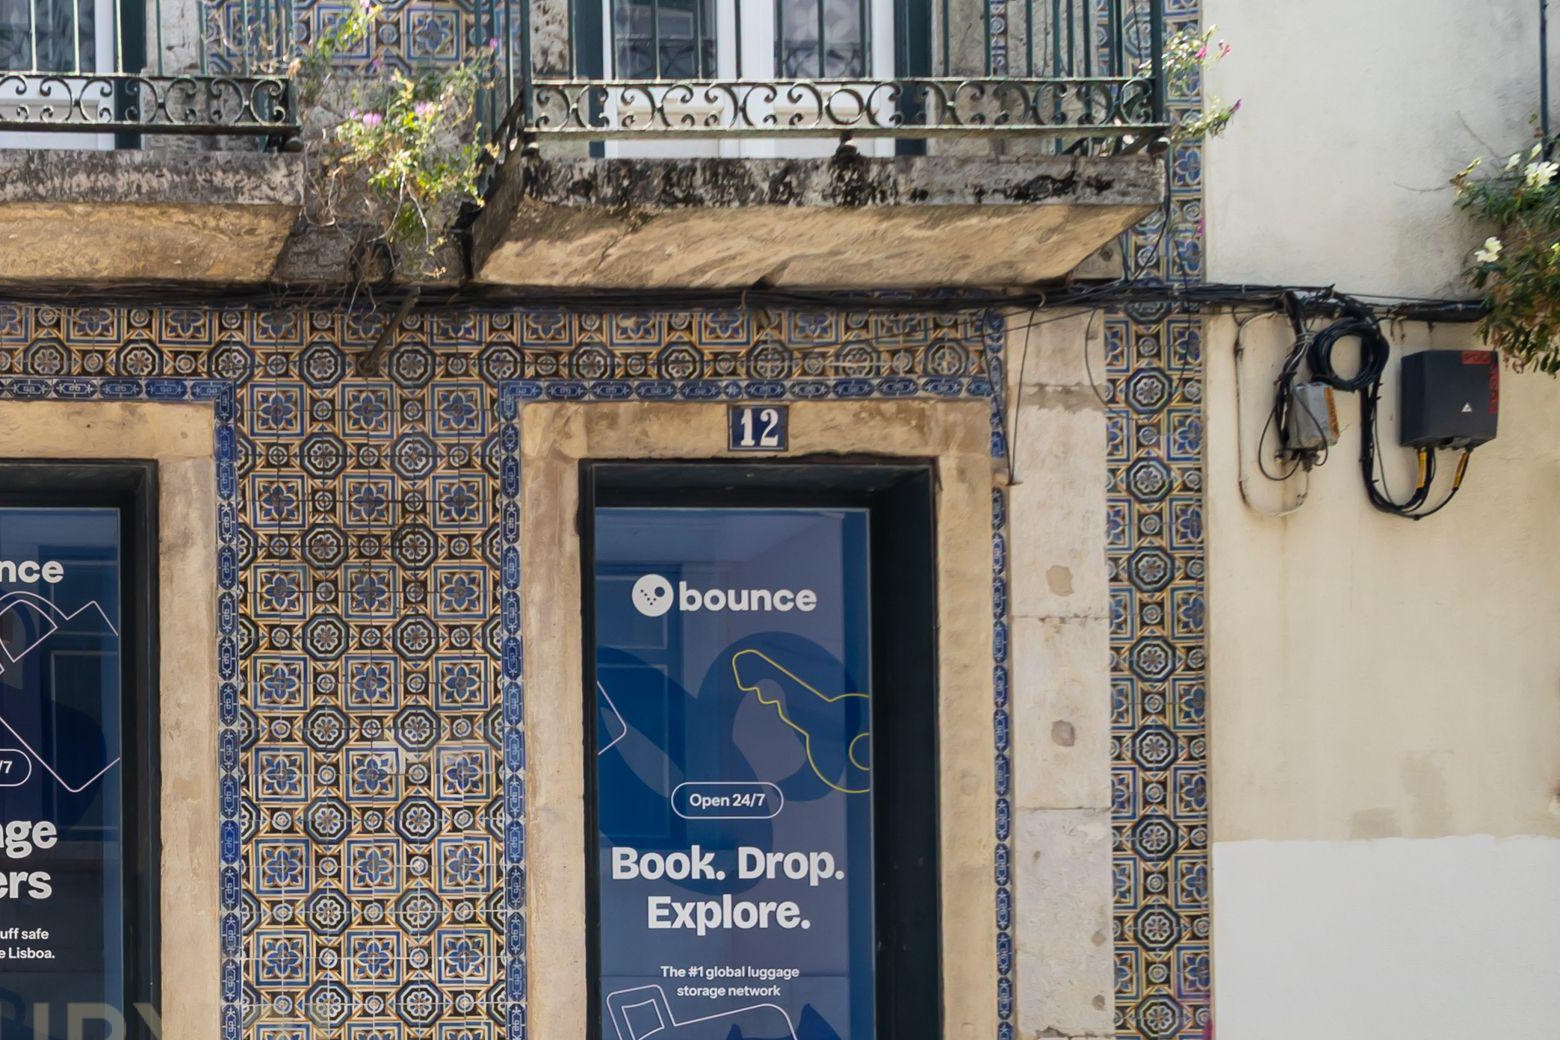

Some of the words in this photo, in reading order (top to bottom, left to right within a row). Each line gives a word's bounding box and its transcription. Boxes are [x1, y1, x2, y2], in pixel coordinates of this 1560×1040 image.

[741, 409, 779, 446] 12
[680, 581, 817, 611] bounce
[690, 794, 729, 809] Open
[733, 794, 765, 807] 24/7
[612, 845, 725, 880] Book.
[738, 847, 844, 886] Drop.
[648, 894, 810, 936] Explore.
[22, 928, 49, 939] safe
[9, 947, 54, 958] Lisboa.
[661, 966, 686, 977] The
[688, 966, 703, 977] #1
[706, 966, 745, 980] global
[748, 966, 799, 980] luggage
[677, 986, 726, 998] storage
[728, 985, 780, 996] network
